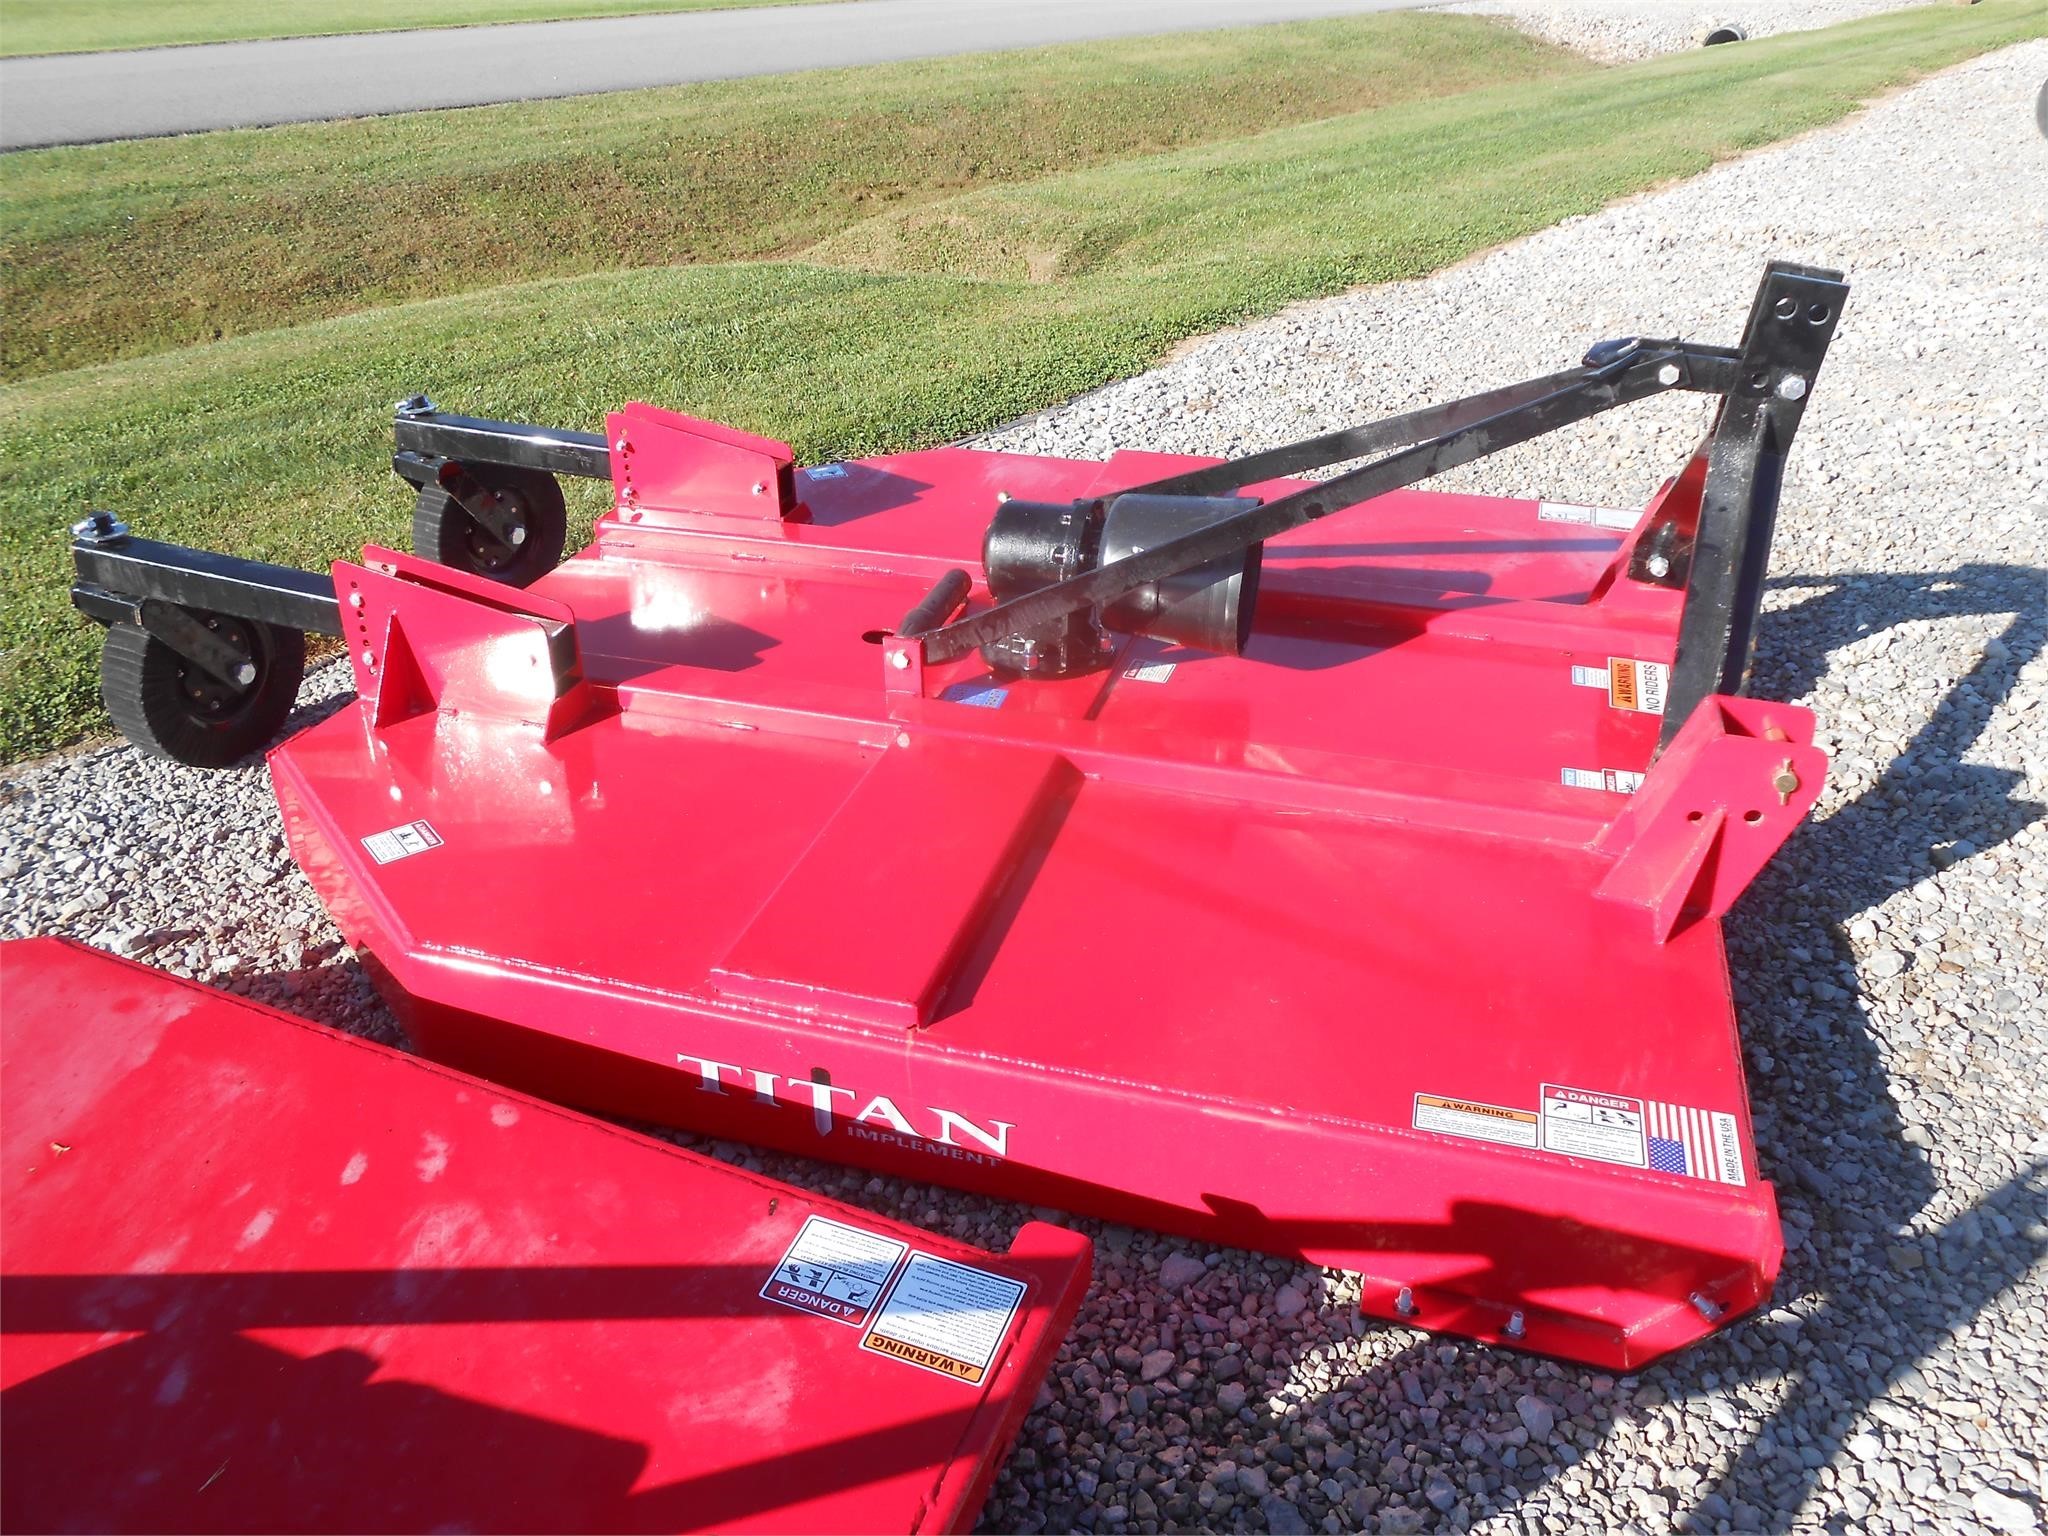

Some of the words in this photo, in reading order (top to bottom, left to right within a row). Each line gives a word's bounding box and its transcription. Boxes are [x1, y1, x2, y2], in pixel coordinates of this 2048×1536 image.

[1617, 664, 1632, 694] WARNING
[1643, 664, 1659, 695] RIDERS
[1646, 697, 1660, 711] NO
[677, 1053, 1017, 1155] TITAN
[1568, 1092, 1628, 1109] DANGER
[1453, 1103, 1513, 1117] WARNING
[1719, 1117, 1729, 1132] USA
[847, 1126, 1005, 1167] IMPLEMENT
[1721, 1133, 1731, 1147] THE
[1723, 1148, 1732, 1156] IN
[1724, 1157, 1736, 1180] MADE
[776, 1285, 841, 1313] DANGER
[870, 1336, 956, 1371] WARNING
[924, 1342, 947, 1353] serious
[949, 1349, 975, 1362] prevent
